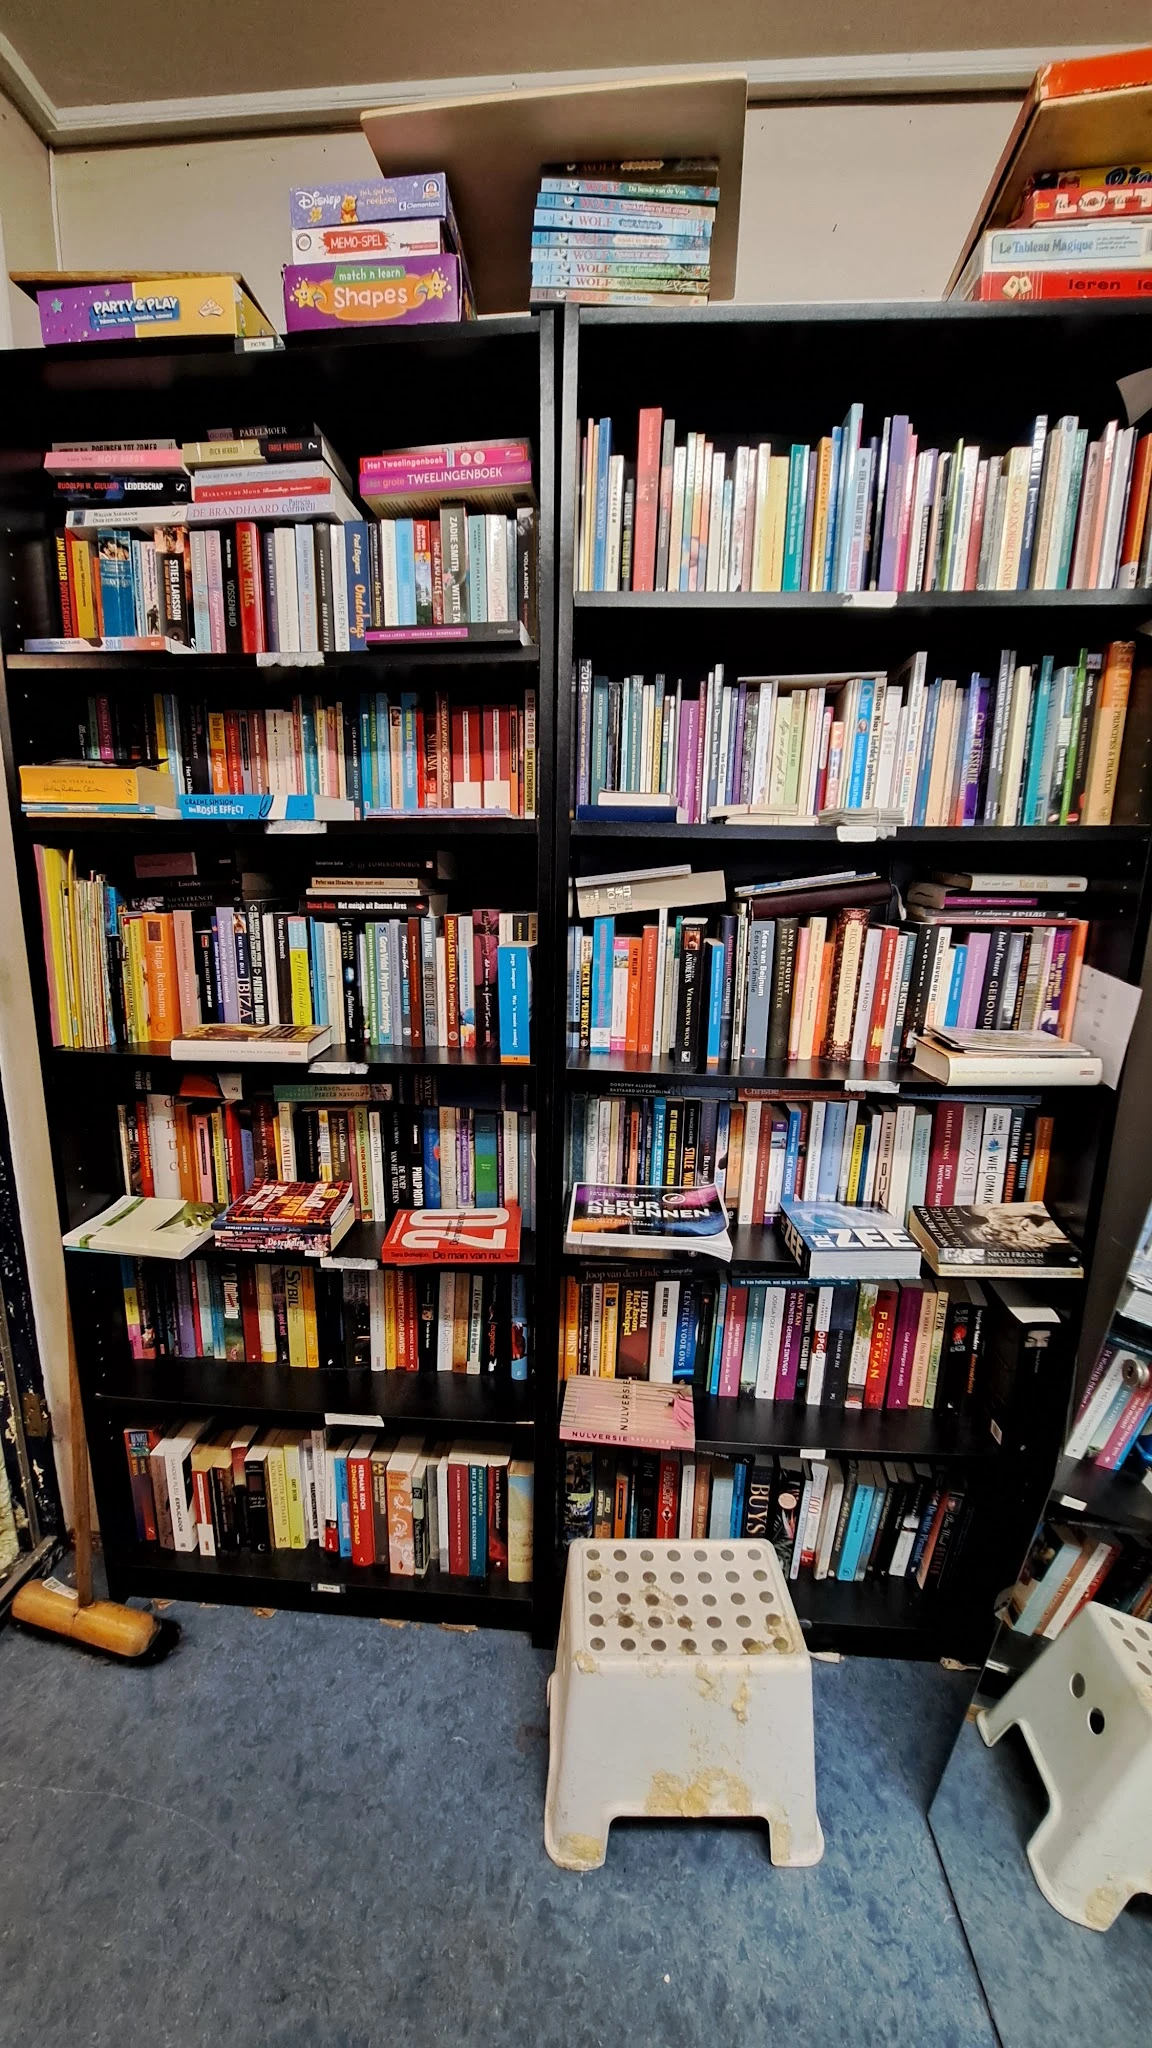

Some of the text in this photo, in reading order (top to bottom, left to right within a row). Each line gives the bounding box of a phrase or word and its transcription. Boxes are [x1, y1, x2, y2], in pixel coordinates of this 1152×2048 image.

[406, 201, 440, 210] Clementoni
[579, 215, 614, 227] WOLF
[331, 234, 383, 249] MEMO-SPEL
[574, 250, 611, 261] WOLF
[1000, 243, 1012, 254] Le
[1012, 241, 1050, 254] Tableau
[1052, 239, 1094, 254] Magique
[339, 268, 401, 281] match n learn
[576, 277, 612, 287] WOLF
[577, 264, 611, 273] WOLF
[333, 287, 408, 309] Shapes
[1069, 279, 1121, 291] leren
[93, 297, 178, 315] PARTY & PLAY
[239, 426, 288, 437] PARELMOER
[367, 456, 444, 469] Het Tweelingenboek
[124, 481, 164, 491] LEIDERSCHAP
[382, 478, 405, 489] grote
[407, 467, 502, 485] TWEELINGENBOEK
[193, 503, 279, 518] DE BRANDHAARD
[282, 502, 316, 513] Cornwell
[1011, 488, 1022, 513] GOD
[449, 516, 458, 543] ZADIE
[56, 537, 68, 581] JAN MULDER
[241, 531, 254, 607] FANNY HILL
[450, 544, 459, 572] SMITH
[169, 559, 181, 620] STIEG LARSSON
[1003, 564, 1013, 588] NIET
[226, 580, 237, 627] VOSSENHUID
[350, 584, 370, 638] Onderlangs
[451, 584, 460, 610] WITTE
[581, 665, 590, 692] 2012
[875, 685, 885, 711] Wilson
[1108, 710, 1121, 750] PRINCIPES
[427, 734, 437, 771] SULTANA
[850, 685, 873, 808] Char innerlijke wijsheid
[869, 735, 879, 763] Liefde's
[967, 739, 983, 784] DE ESSENTIE
[1103, 758, 1115, 794] PRAKTIJK
[864, 764, 874, 800] geheimen
[196, 804, 244, 815] ROSIE EFFECT
[447, 920, 456, 952] DOUGLAS
[761, 930, 769, 948] Kees
[995, 931, 1007, 951] Isabel
[448, 954, 457, 983] REEMAN
[685, 952, 693, 983] ANDREWS
[784, 956, 792, 994] ENQUIST
[843, 928, 858, 994] RECENT VERLEDEN
[991, 952, 1004, 977] Fonseca
[155, 945, 167, 1017] Helga Ruebsamen
[750, 968, 759, 993] familie
[756, 965, 766, 996] Beijnum
[776, 949, 786, 1008] MEESTERSTUK
[238, 978, 252, 1018] IBIZA
[447, 993, 456, 1024] vrijwilligers
[580, 961, 591, 1037] PICTURE PERFECT.
[685, 987, 694, 1025] VERDORVEN
[723, 977, 732, 1014] Contrapunt
[862, 982, 871, 1012] KLAPROOS
[896, 981, 909, 1026] DE KETTING
[943, 1110, 953, 1160] HARRIET EVANS
[282, 1138, 291, 1173] FAMILIE
[684, 1147, 695, 1169] STILLE
[703, 1155, 711, 1179] BLINDE
[962, 1149, 975, 1184] ZUSJE
[784, 1169, 792, 1194] WONDER
[944, 1164, 952, 1179] Een
[983, 1155, 998, 1204] WIE OMKIJK
[412, 1167, 423, 1206] PHILIP ROTH
[587, 1206, 710, 1218] BEKENNEN
[588, 1200, 660, 1210] KLEUR
[827, 1229, 922, 1249] ZEE
[586, 1270, 606, 1279] Joop
[607, 1270, 620, 1278] van
[622, 1269, 639, 1278] den
[639, 1268, 660, 1277] Ende
[286, 1270, 300, 1307] SYBIL
[623, 1290, 633, 1336] dubbelspel
[631, 1290, 640, 1332] Het Jason
[640, 1290, 649, 1328] LUDLUM
[935, 1298, 947, 1331] DE PLEK
[567, 1329, 577, 1356] DORST
[678, 1290, 691, 1366] EEN PLEK VOOR ONS
[870, 1311, 888, 1379] POSTMAN
[621, 1380, 631, 1431] NULVERSIE
[572, 1431, 628, 1442] NULVERSIE
[662, 1471, 675, 1507] MACHT
[175, 1497, 183, 1532] EXPLICADOR
[747, 1482, 769, 1534] BUYS
[808, 1496, 822, 1514] 100
